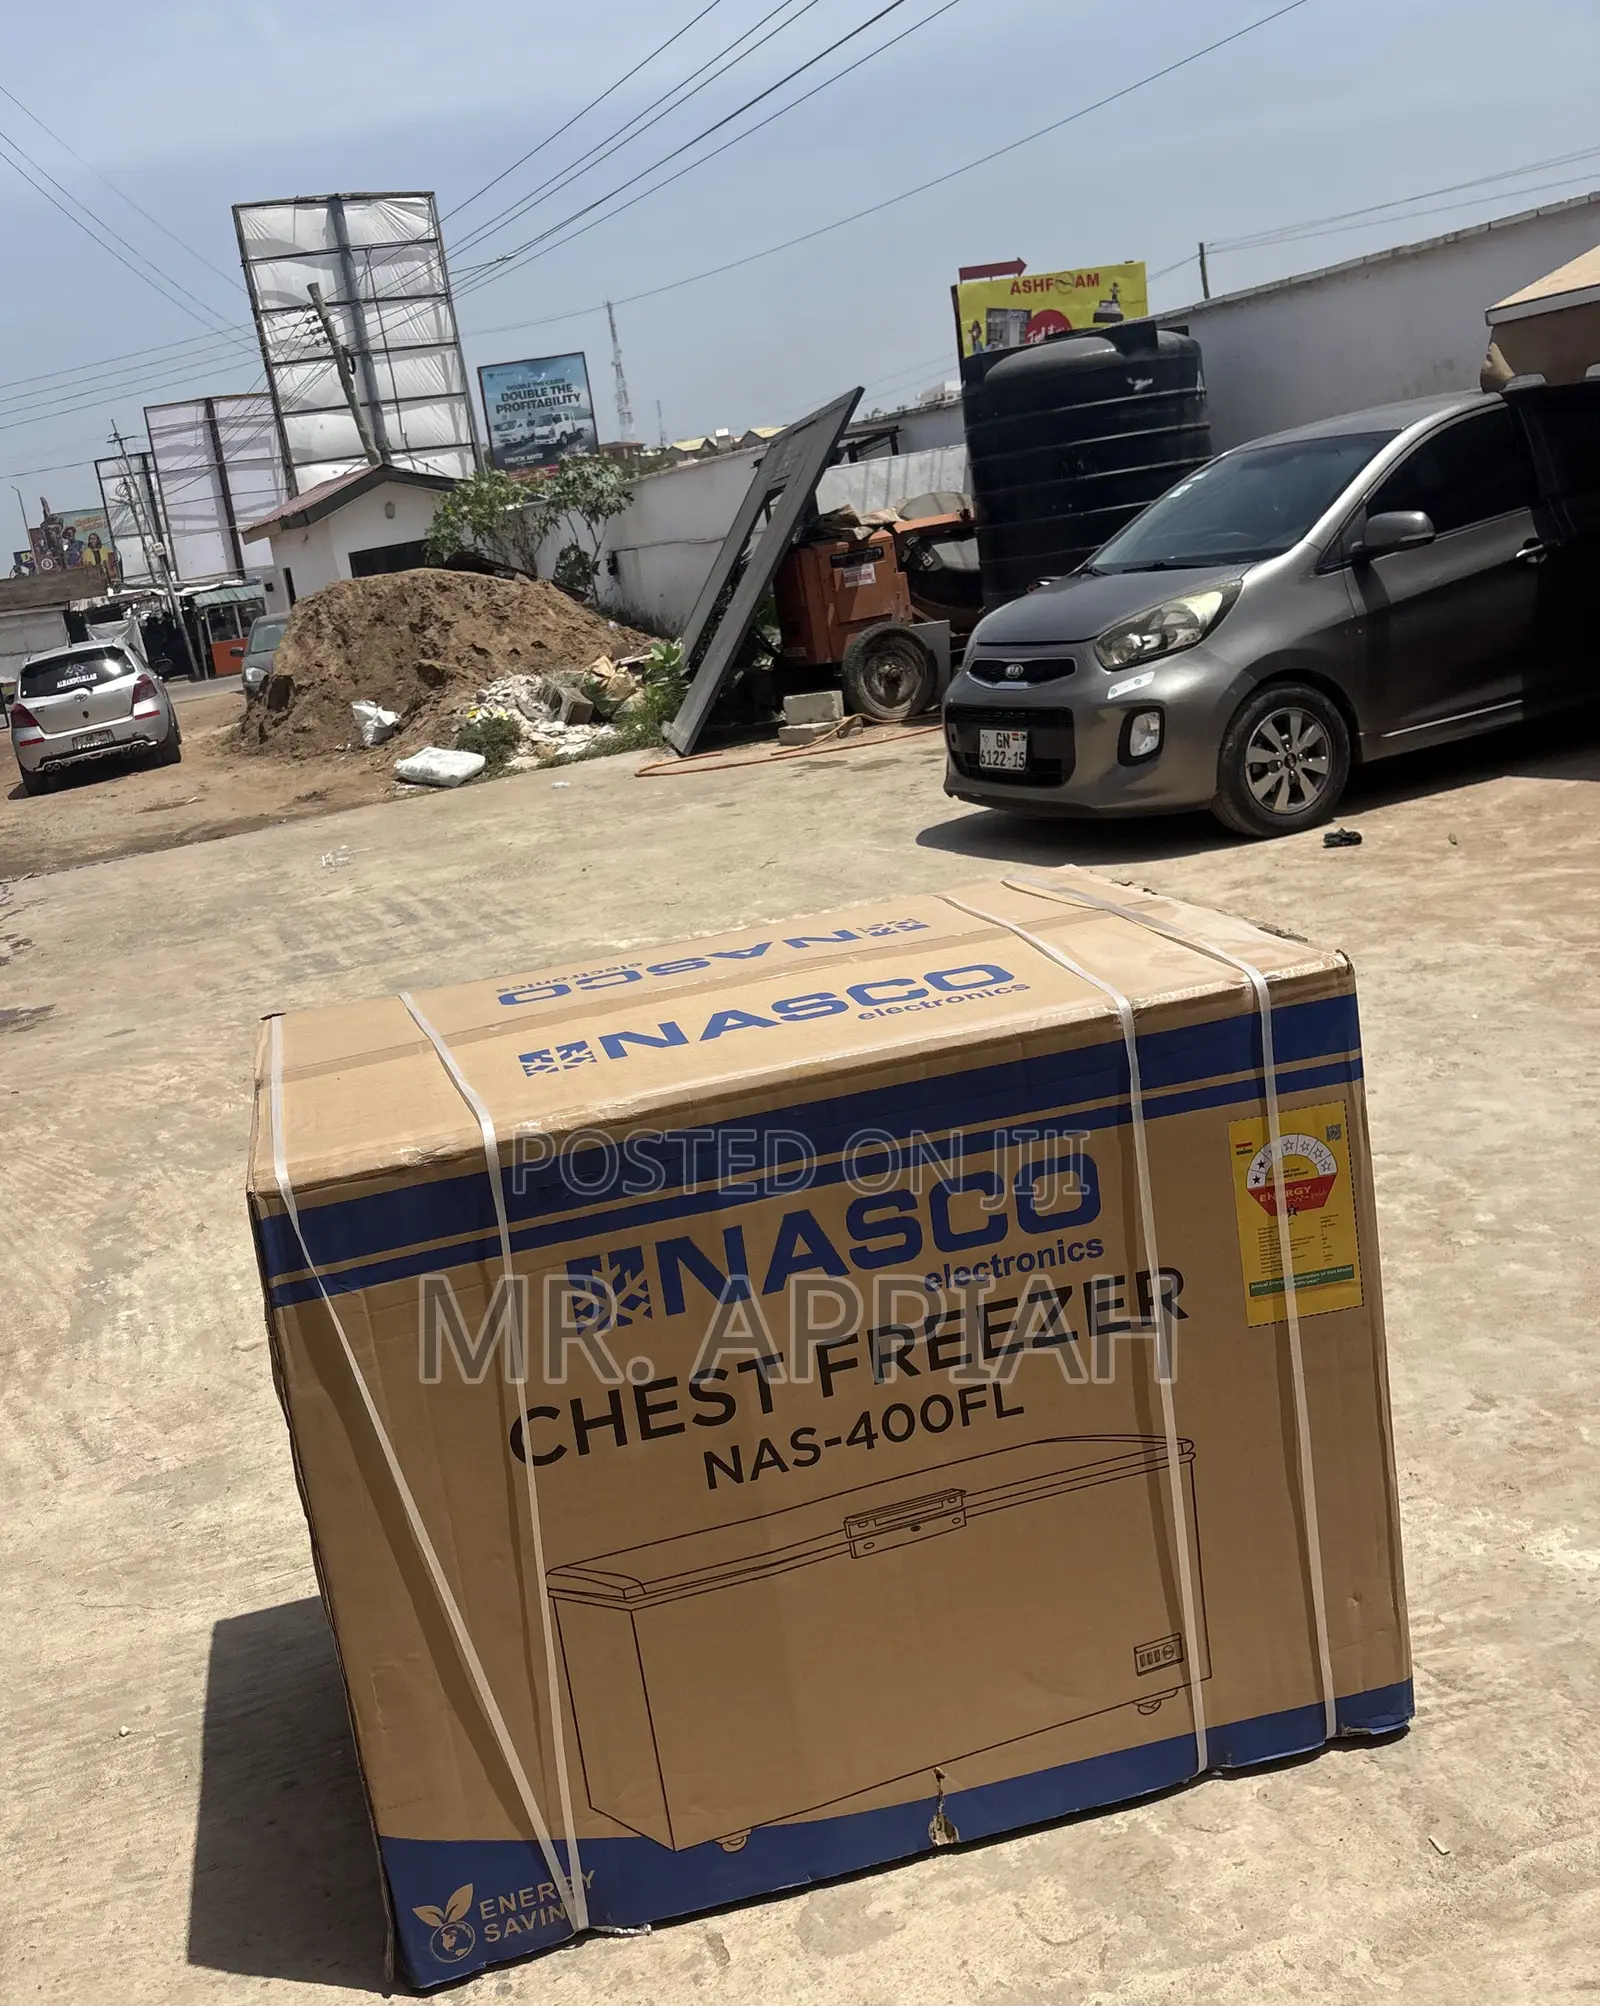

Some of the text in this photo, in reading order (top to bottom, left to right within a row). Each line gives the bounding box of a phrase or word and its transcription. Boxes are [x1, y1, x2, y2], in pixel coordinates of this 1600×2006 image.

[496, 393, 581, 414] PROFITABILITY
[501, 383, 574, 402] DOUBLE THE
[980, 749, 1025, 768] 6122-15
[996, 732, 1010, 748] GN
[496, 962, 643, 993] electronics
[498, 930, 863, 1006] NASCO
[598, 964, 1015, 1059] NASCO
[858, 983, 1031, 1021] electronics
[1260, 1185, 1312, 1203] ENRGY
[657, 1153, 1101, 1316] NASCO
[924, 1238, 1104, 1292] electronics
[510, 1267, 1190, 1466] CHEST FREEZER
[703, 1381, 1024, 1490] NAS-400FL
[479, 1869, 595, 1920] ENERY
[484, 1902, 569, 1943] SAVIN
